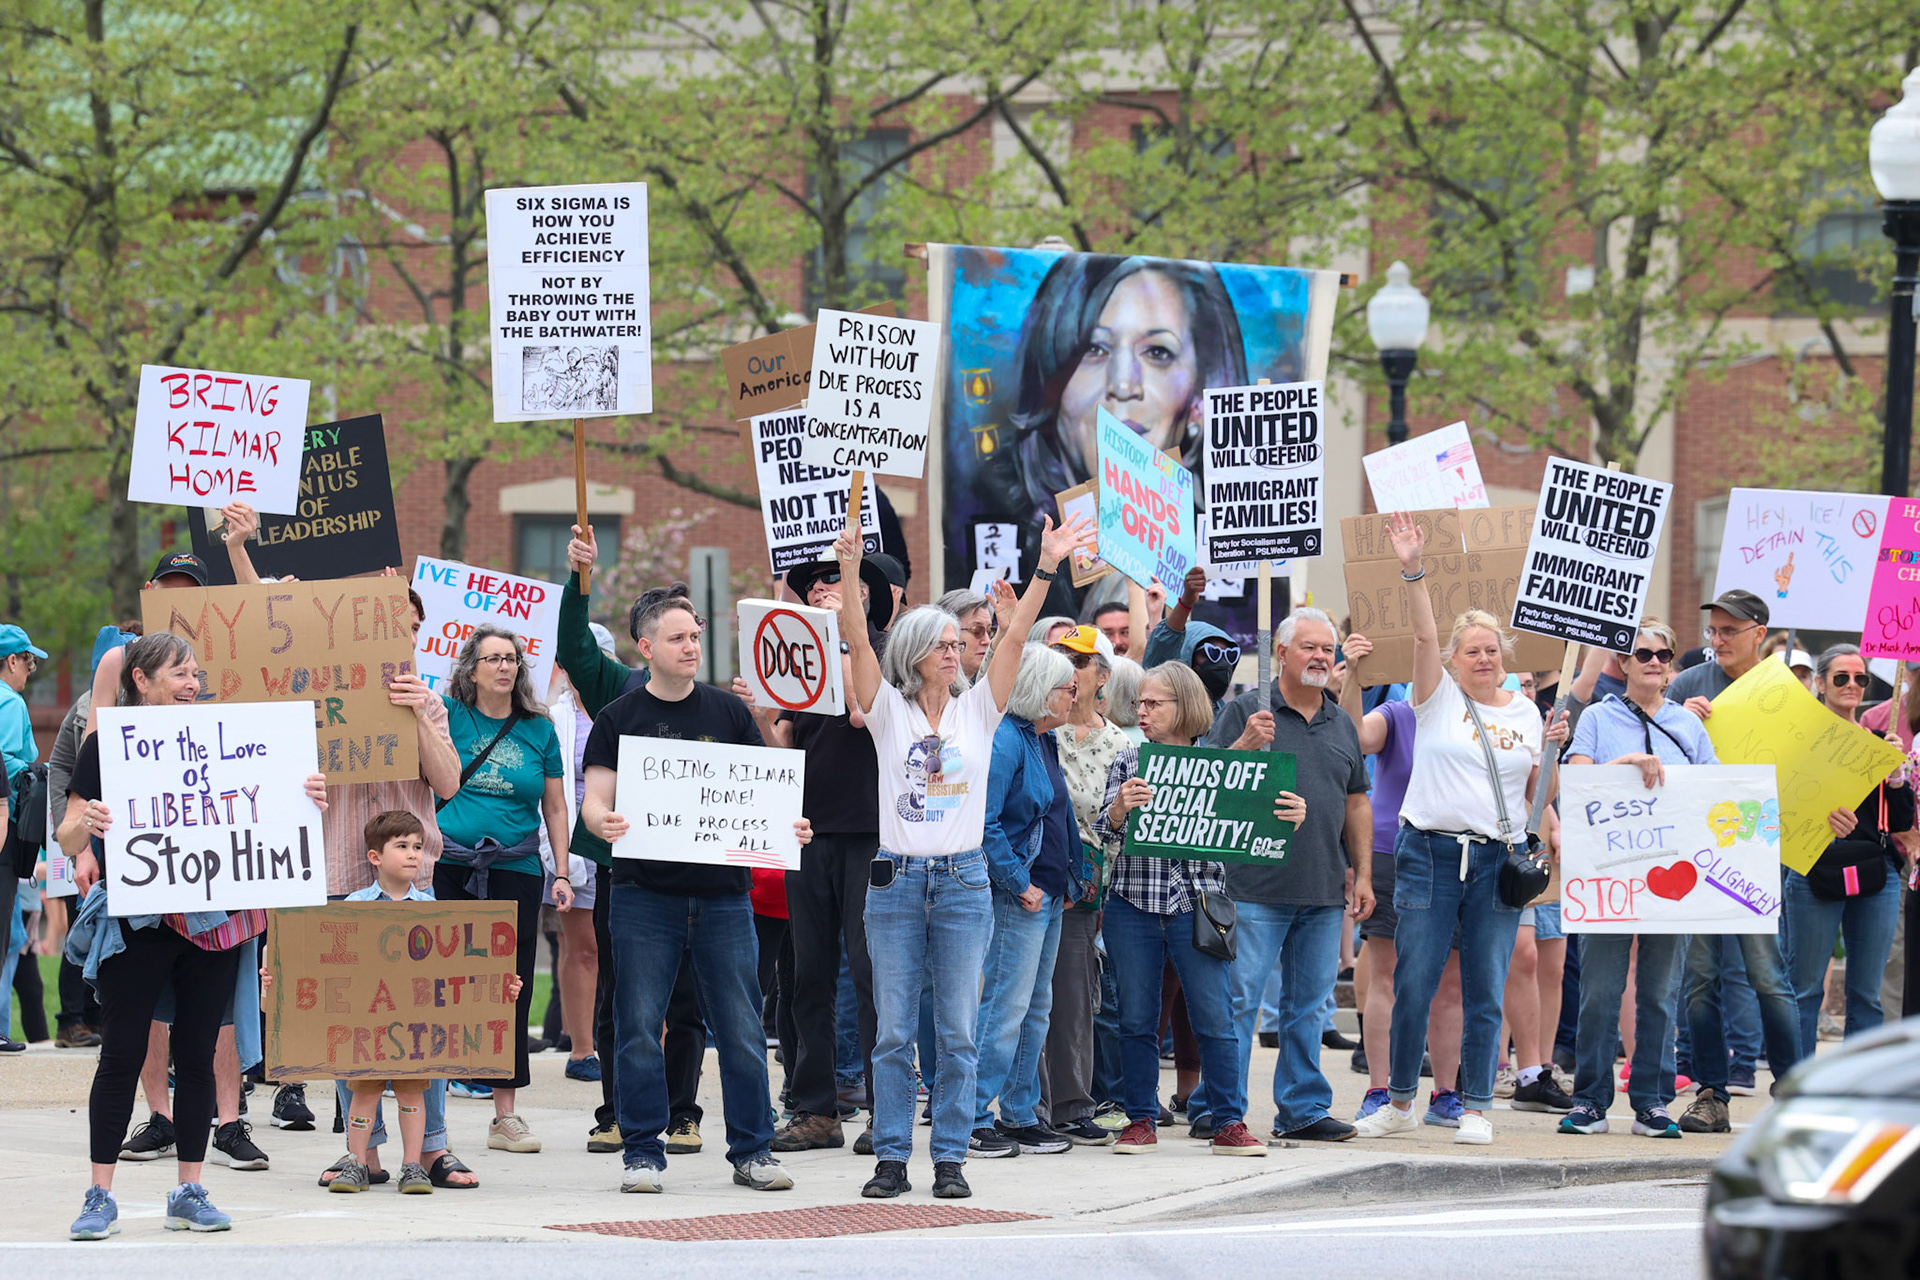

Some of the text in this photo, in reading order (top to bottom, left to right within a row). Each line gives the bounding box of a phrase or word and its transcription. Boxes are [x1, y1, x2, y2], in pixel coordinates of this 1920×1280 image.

[516, 197, 630, 210] SIX SIGMA IS
[532, 215, 614, 227] HOW YOU
[535, 233, 612, 245] ACHIEVE
[522, 250, 625, 263] EFFICIENCY
[542, 277, 602, 288] NOT BY
[509, 294, 634, 306] THROWING THE
[507, 310, 636, 322] BABY OUT WITH
[500, 326, 641, 338] THE BATHWATER!
[839, 318, 915, 345] PRISON
[748, 355, 785, 374] Our
[830, 344, 919, 372] WITHOUT
[161, 373, 279, 416] BRING
[819, 370, 922, 400] DUE PROCESS
[845, 399, 880, 418] IS A
[1210, 388, 1317, 414] THE PEOPLE
[303, 428, 341, 451] ERY
[759, 415, 806, 438] MONE
[808, 418, 926, 450] CONCENTRATION
[1212, 411, 1318, 449] UNITED
[168, 420, 281, 467] KILMAR
[834, 448, 888, 469] CAMP
[1104, 424, 1148, 472] HISTORY
[1211, 444, 1317, 468] WILL DEFEND
[306, 446, 362, 474] ABLE
[169, 463, 257, 496] HOME
[300, 470, 358, 497] NIUS
[1160, 476, 1184, 510] DEI
[1212, 477, 1318, 503] IMMIGRANT
[1553, 465, 1663, 507] THE PEOPLE
[300, 497, 330, 518] OF
[770, 494, 817, 524] NOT
[1105, 457, 1180, 536] HANDS
[773, 513, 872, 540] WAR MACHE!
[1212, 500, 1316, 530] FAMILIES!
[1545, 487, 1655, 539] UNITED
[257, 510, 382, 547] LEADERSHIP
[1122, 503, 1163, 559] OFF!
[1213, 541, 1229, 549] Party
[1241, 538, 1276, 546] Socialism
[1277, 536, 1290, 544] and
[1354, 508, 1535, 555] HADS OFF
[1541, 519, 1649, 558] WILL DEFEND
[776, 550, 792, 558] Party
[777, 557, 808, 567] Liberation
[1099, 534, 1154, 581] DEMOCRAC
[1166, 546, 1186, 575] OUR
[1214, 546, 1298, 558] Liberation PSLWeb.org
[1739, 527, 1853, 584] DETAIN THIS
[419, 562, 545, 603] I'VE HEARD
[1155, 560, 1185, 597] RIGHT
[1532, 551, 1644, 594] IMMIGRANT
[464, 591, 531, 620] OF AN
[1525, 574, 1637, 620] FAMILIES!
[169, 593, 408, 661] MY 5 YEAR
[1519, 616, 1555, 630] Liberation
[1566, 627, 1608, 644] PSLWeb.org
[1521, 606, 1540, 618] Party
[1541, 611, 1552, 620] for
[1553, 614, 1588, 627] Socialism
[442, 620, 542, 656] ORGE
[763, 636, 816, 680] DOGE
[260, 663, 366, 697] WOULD
[1736, 664, 1789, 715] NO
[121, 722, 266, 761] For the Love
[183, 763, 211, 795] of
[644, 756, 800, 788] BRING KILMAR
[1144, 755, 1268, 791] HANDS OFF
[701, 787, 754, 806] HOME!
[927, 782, 968, 796] RESISTANCE
[1139, 785, 1217, 817] SOCIAL
[128, 785, 259, 828] LIBERTY
[926, 810, 944, 821] DUTY
[647, 813, 769, 831] DUE PROCESS
[1134, 814, 1254, 849] SECURITY!
[695, 832, 773, 850] FOR ALL
[1607, 826, 1674, 851] RIOT
[121, 833, 220, 901] Stop
[1564, 848, 1782, 922] STOP OLIGARCHY
[320, 921, 516, 964] I COULD
[296, 972, 516, 1013] BE A BETTER
[327, 1019, 509, 1064] PRESIDENT
